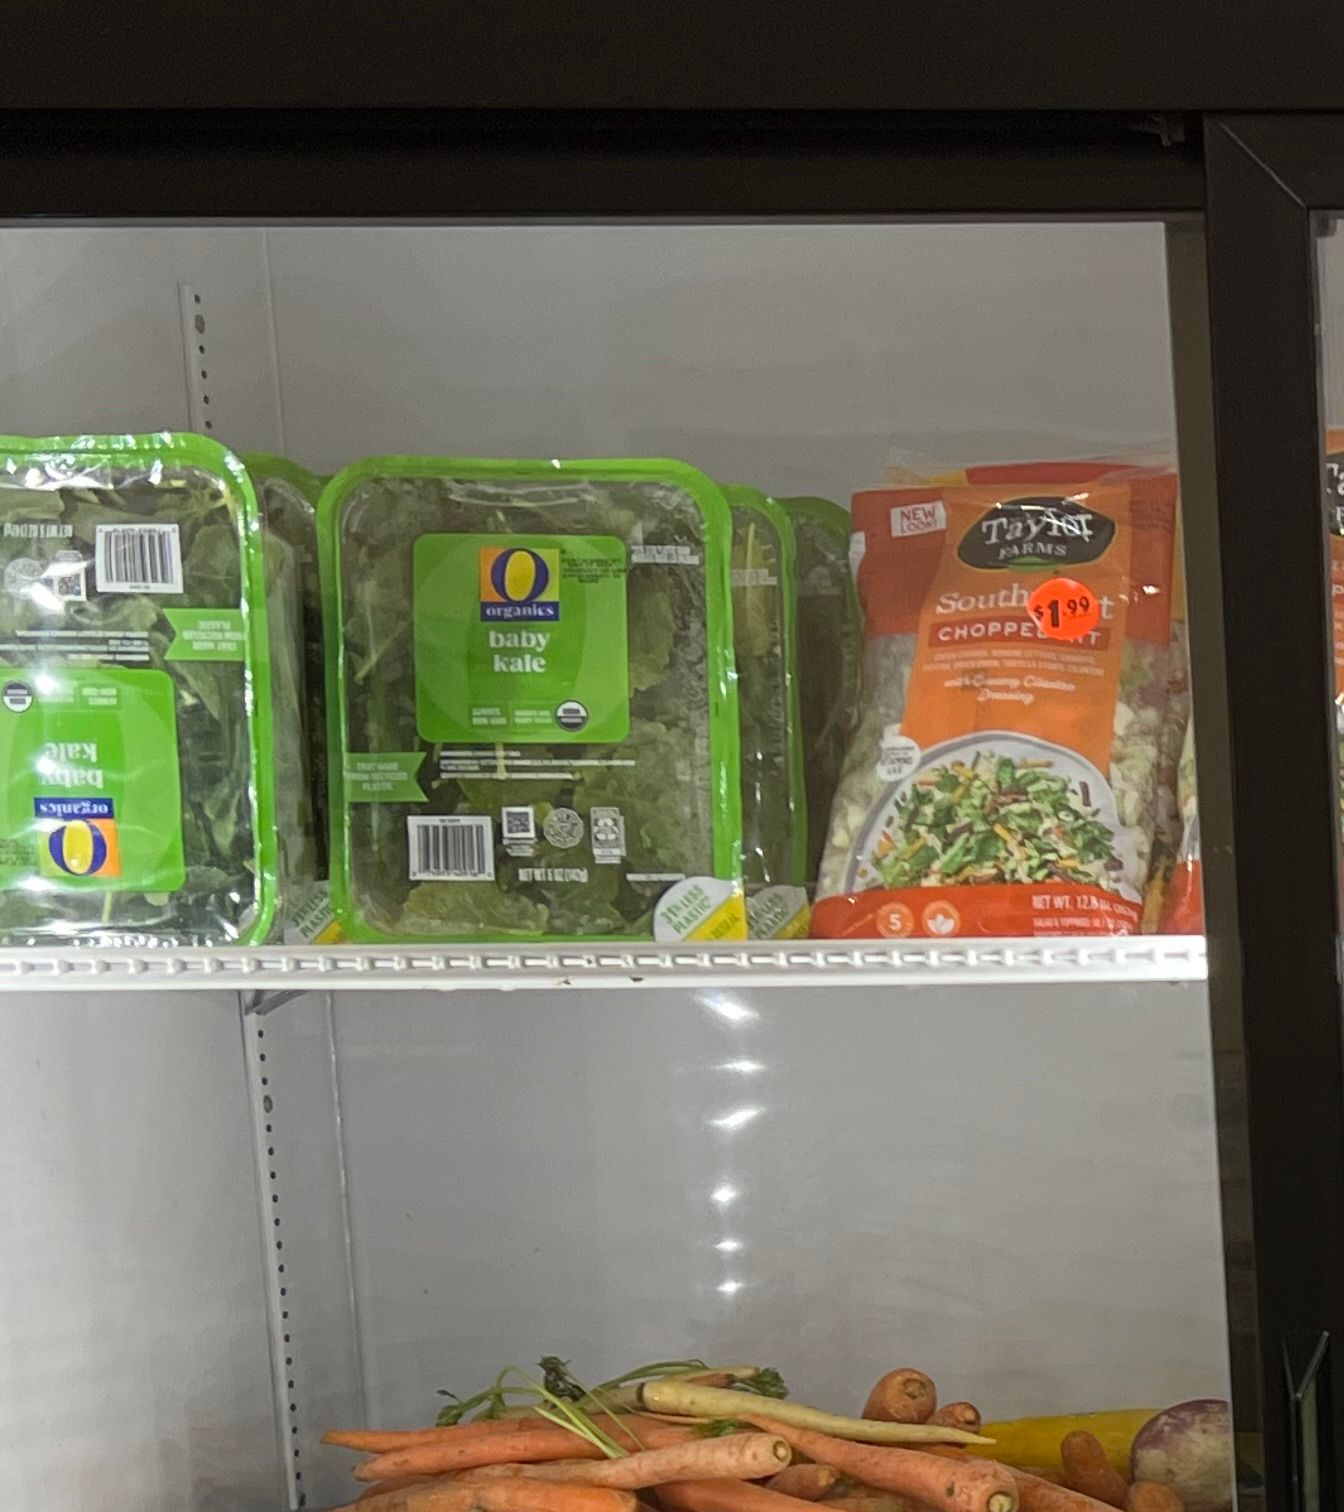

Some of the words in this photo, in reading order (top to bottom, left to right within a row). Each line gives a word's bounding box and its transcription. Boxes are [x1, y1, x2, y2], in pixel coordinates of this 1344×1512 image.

[900, 507, 937, 521] NEW
[982, 508, 1093, 545] Taylor
[998, 543, 1067, 560] FARMS
[485, 603, 554, 619] organics
[936, 583, 1114, 620] Southt
[1033, 596, 1092, 628] $1.99
[489, 630, 552, 651] baby
[493, 654, 546, 673] kale
[44, 742, 98, 763] kale
[39, 799, 111, 817] organics
[1032, 895, 1051, 909] NET
[1053, 895, 1073, 910] WT.
